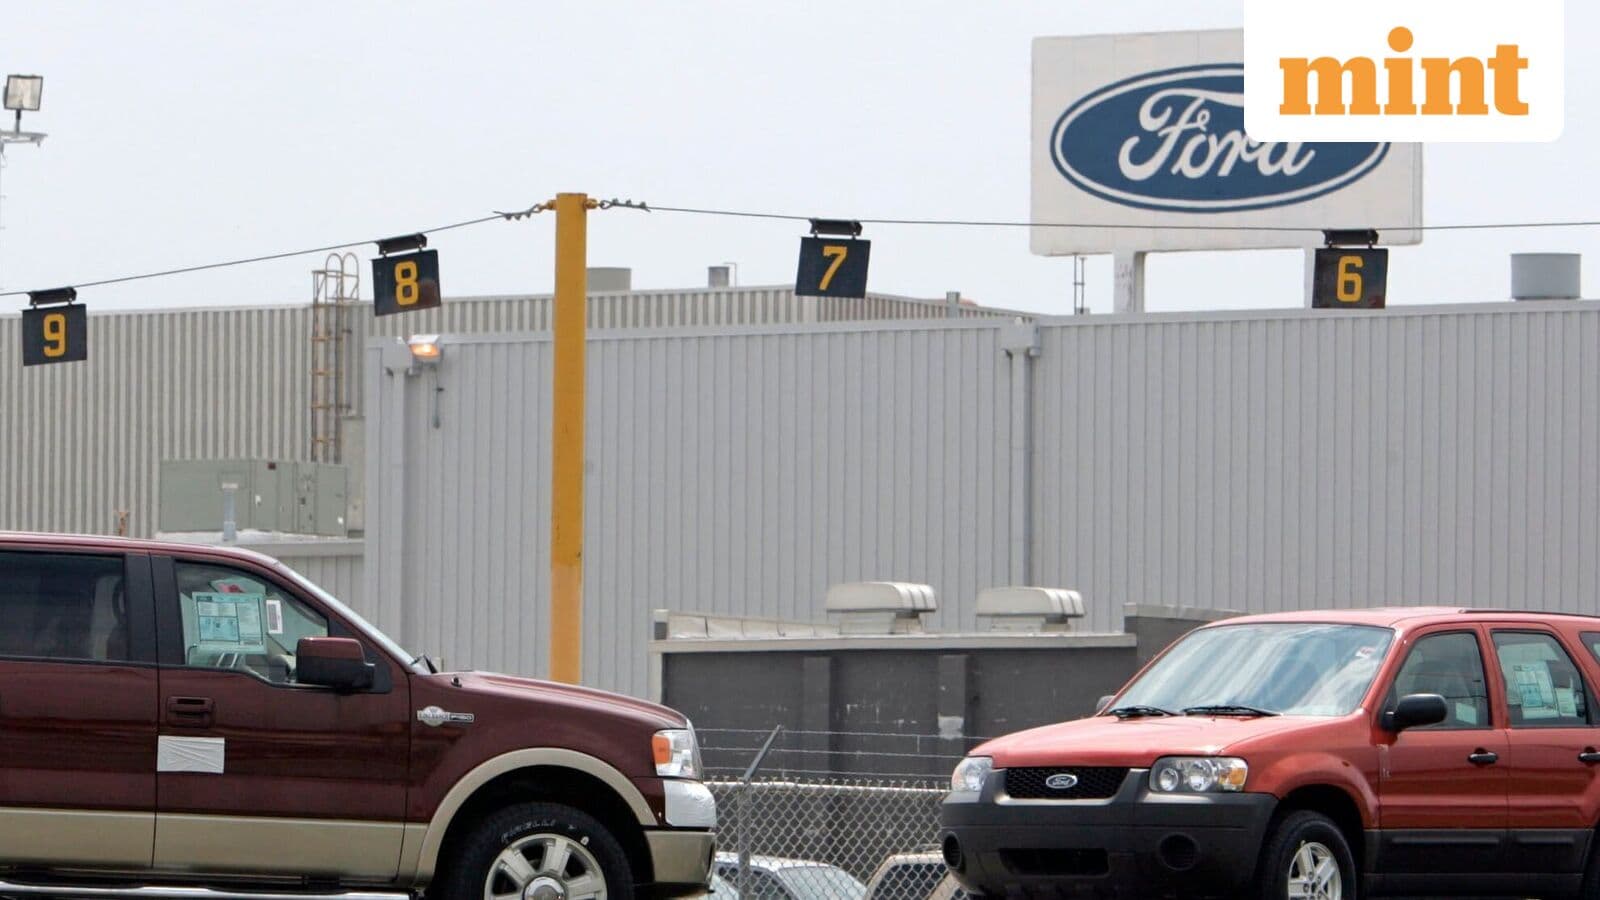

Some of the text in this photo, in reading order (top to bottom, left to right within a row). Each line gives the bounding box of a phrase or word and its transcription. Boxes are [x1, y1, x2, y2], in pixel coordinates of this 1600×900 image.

[394, 261, 418, 306] 8
[819, 246, 847, 290] 7
[1336, 255, 1364, 303] 6
[43, 313, 66, 357] 9
